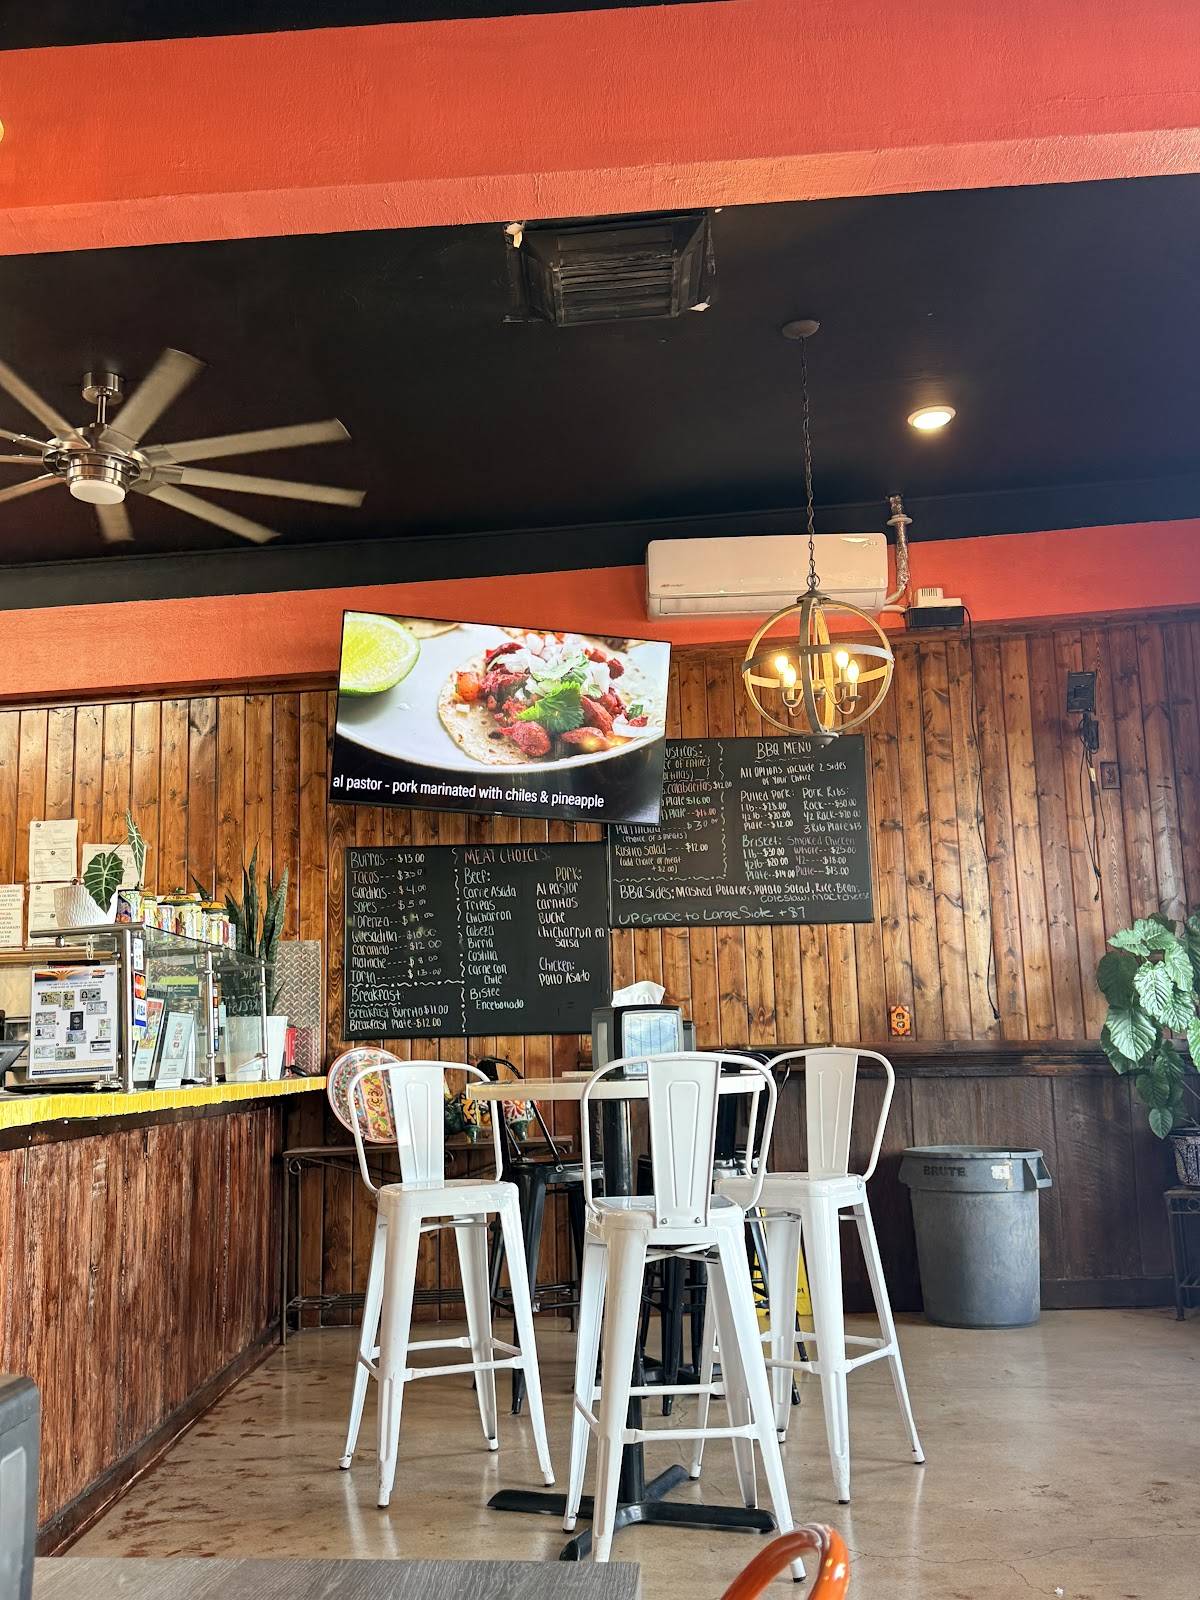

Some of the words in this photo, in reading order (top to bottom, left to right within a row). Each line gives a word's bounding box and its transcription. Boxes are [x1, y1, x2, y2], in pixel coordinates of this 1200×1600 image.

[757, 742, 779, 759] BBQ
[784, 742, 811, 754] MENU
[333, 774, 344, 788] al
[346, 775, 383, 791] pastor
[392, 778, 418, 794] pork
[420, 781, 476, 798] marinated
[479, 785, 502, 800] with
[505, 787, 538, 803] chiles
[540, 791, 548, 804] &
[551, 792, 605, 810] pineapple
[923, 1165, 967, 1177] BRUTE
